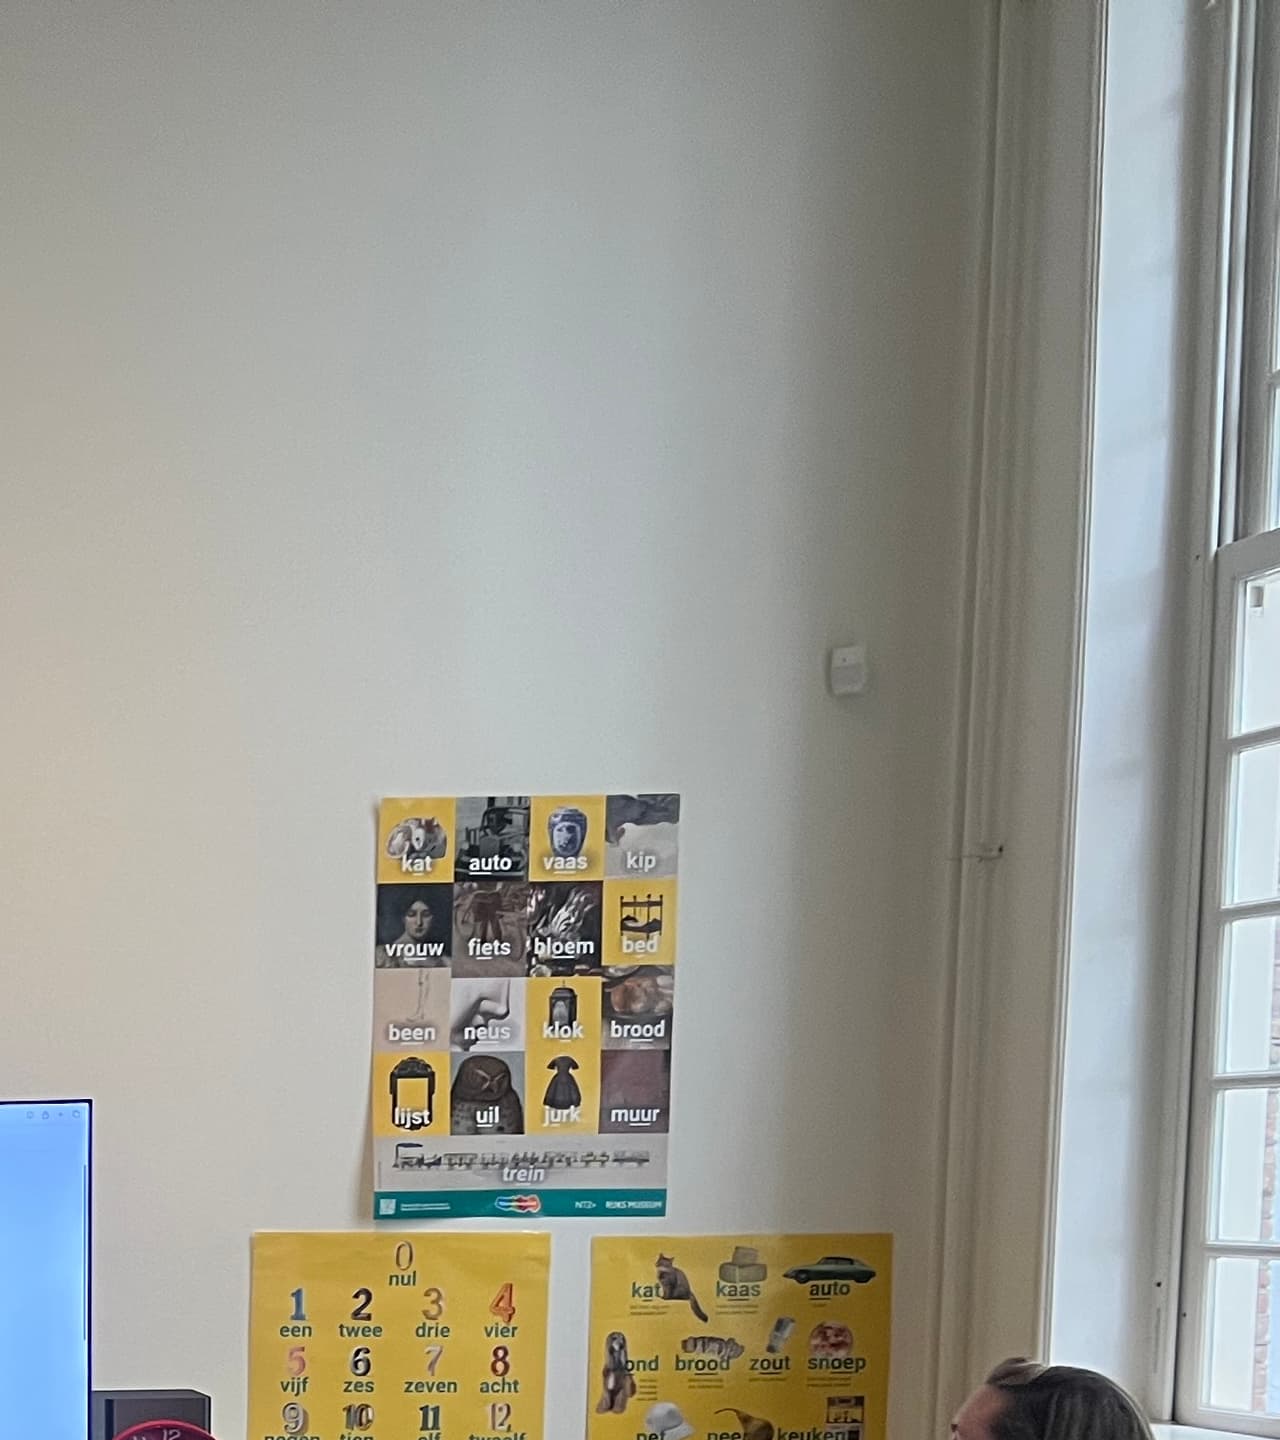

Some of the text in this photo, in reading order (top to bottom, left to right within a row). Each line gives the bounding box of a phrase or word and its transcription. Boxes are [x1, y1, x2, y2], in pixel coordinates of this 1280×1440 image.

[402, 855, 432, 872] kat
[469, 856, 512, 871] auto
[543, 856, 588, 869] vaas
[626, 852, 656, 871] kip
[385, 941, 445, 957] vrouw
[468, 938, 511, 956] fiets
[534, 937, 595, 955] bloem
[622, 935, 659, 953] bed
[389, 1024, 435, 1041] been
[464, 1026, 511, 1040] neus
[543, 1022, 584, 1039] klok
[610, 1020, 665, 1038] brood
[394, 1107, 431, 1126] lijst
[476, 1106, 499, 1123] uil
[543, 1106, 581, 1126] jurk
[611, 1108, 660, 1122] muur
[502, 1166, 545, 1182] trein
[389, 1272, 416, 1286] nul
[632, 1282, 662, 1298] kat
[716, 1281, 761, 1297] kaas
[810, 1282, 851, 1296] auto
[290, 1288, 307, 1321] 1
[351, 1288, 373, 1321] 2
[422, 1288, 443, 1320] 3
[490, 1283, 516, 1323] 4
[280, 1325, 312, 1337] een
[339, 1324, 382, 1337] twee
[416, 1323, 450, 1337] drie
[484, 1323, 518, 1337] vier
[288, 1346, 306, 1376] 5
[351, 1347, 371, 1376] 6
[425, 1345, 443, 1376] 7
[491, 1346, 510, 1376] 8
[624, 1356, 659, 1372] ond
[675, 1355, 730, 1371] brood
[750, 1356, 790, 1371] zout
[807, 1356, 866, 1374] snoep
[280, 1377, 309, 1396] vijf
[344, 1381, 374, 1393] zes
[404, 1381, 457, 1393] zeven
[480, 1378, 519, 1393] acht
[282, 1403, 305, 1434] 9
[343, 1404, 373, 1431] 10
[419, 1405, 440, 1431] 11
[491, 1403, 511, 1432] 12
